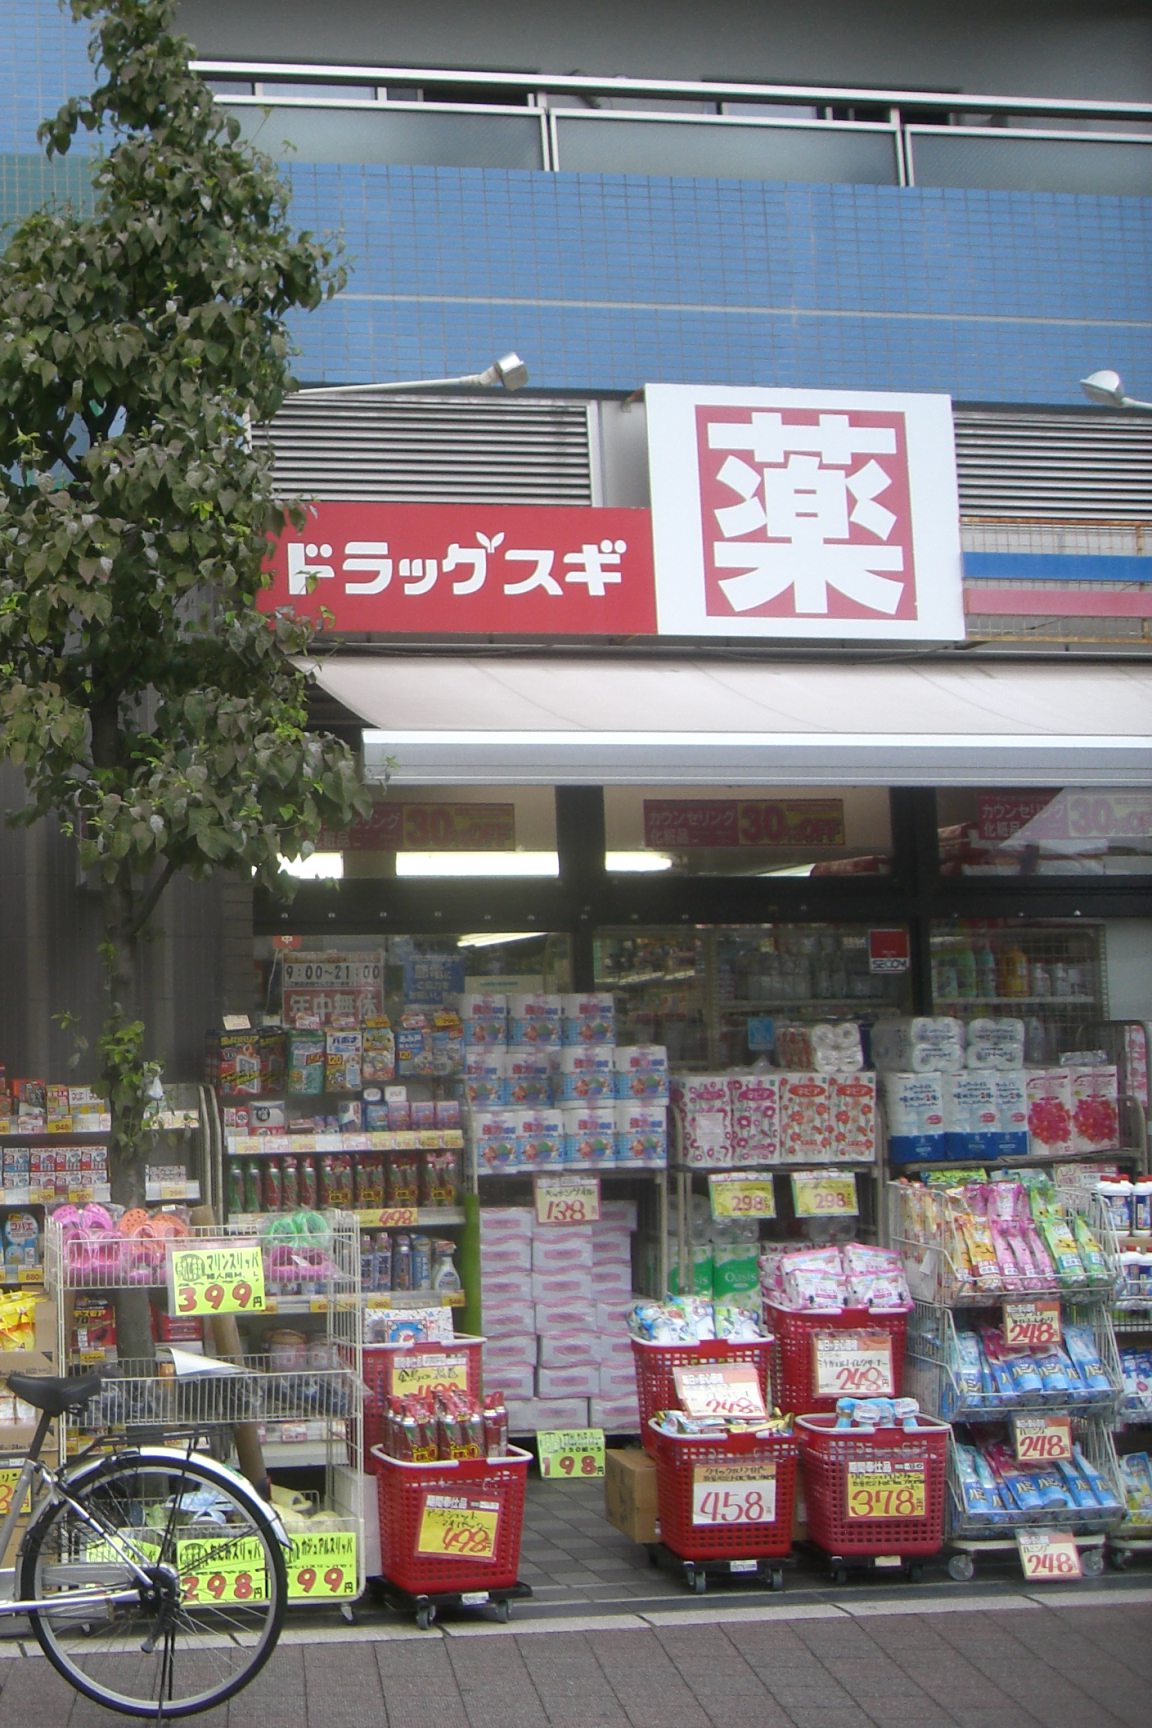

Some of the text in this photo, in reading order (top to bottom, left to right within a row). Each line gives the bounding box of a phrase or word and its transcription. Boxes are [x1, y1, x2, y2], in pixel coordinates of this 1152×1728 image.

[706, 412, 906, 615] 薬
[287, 531, 627, 596] ドラッグスギ
[649, 809, 736, 826] カウンセリング
[872, 959, 908, 971] SECOM
[290, 993, 377, 1021] 年中無休
[10, 1222, 33, 1231] コバエ
[206, 1251, 259, 1270] マリンスリッパ
[724, 1270, 757, 1283] Oasis
[178, 1282, 263, 1312] 399円
